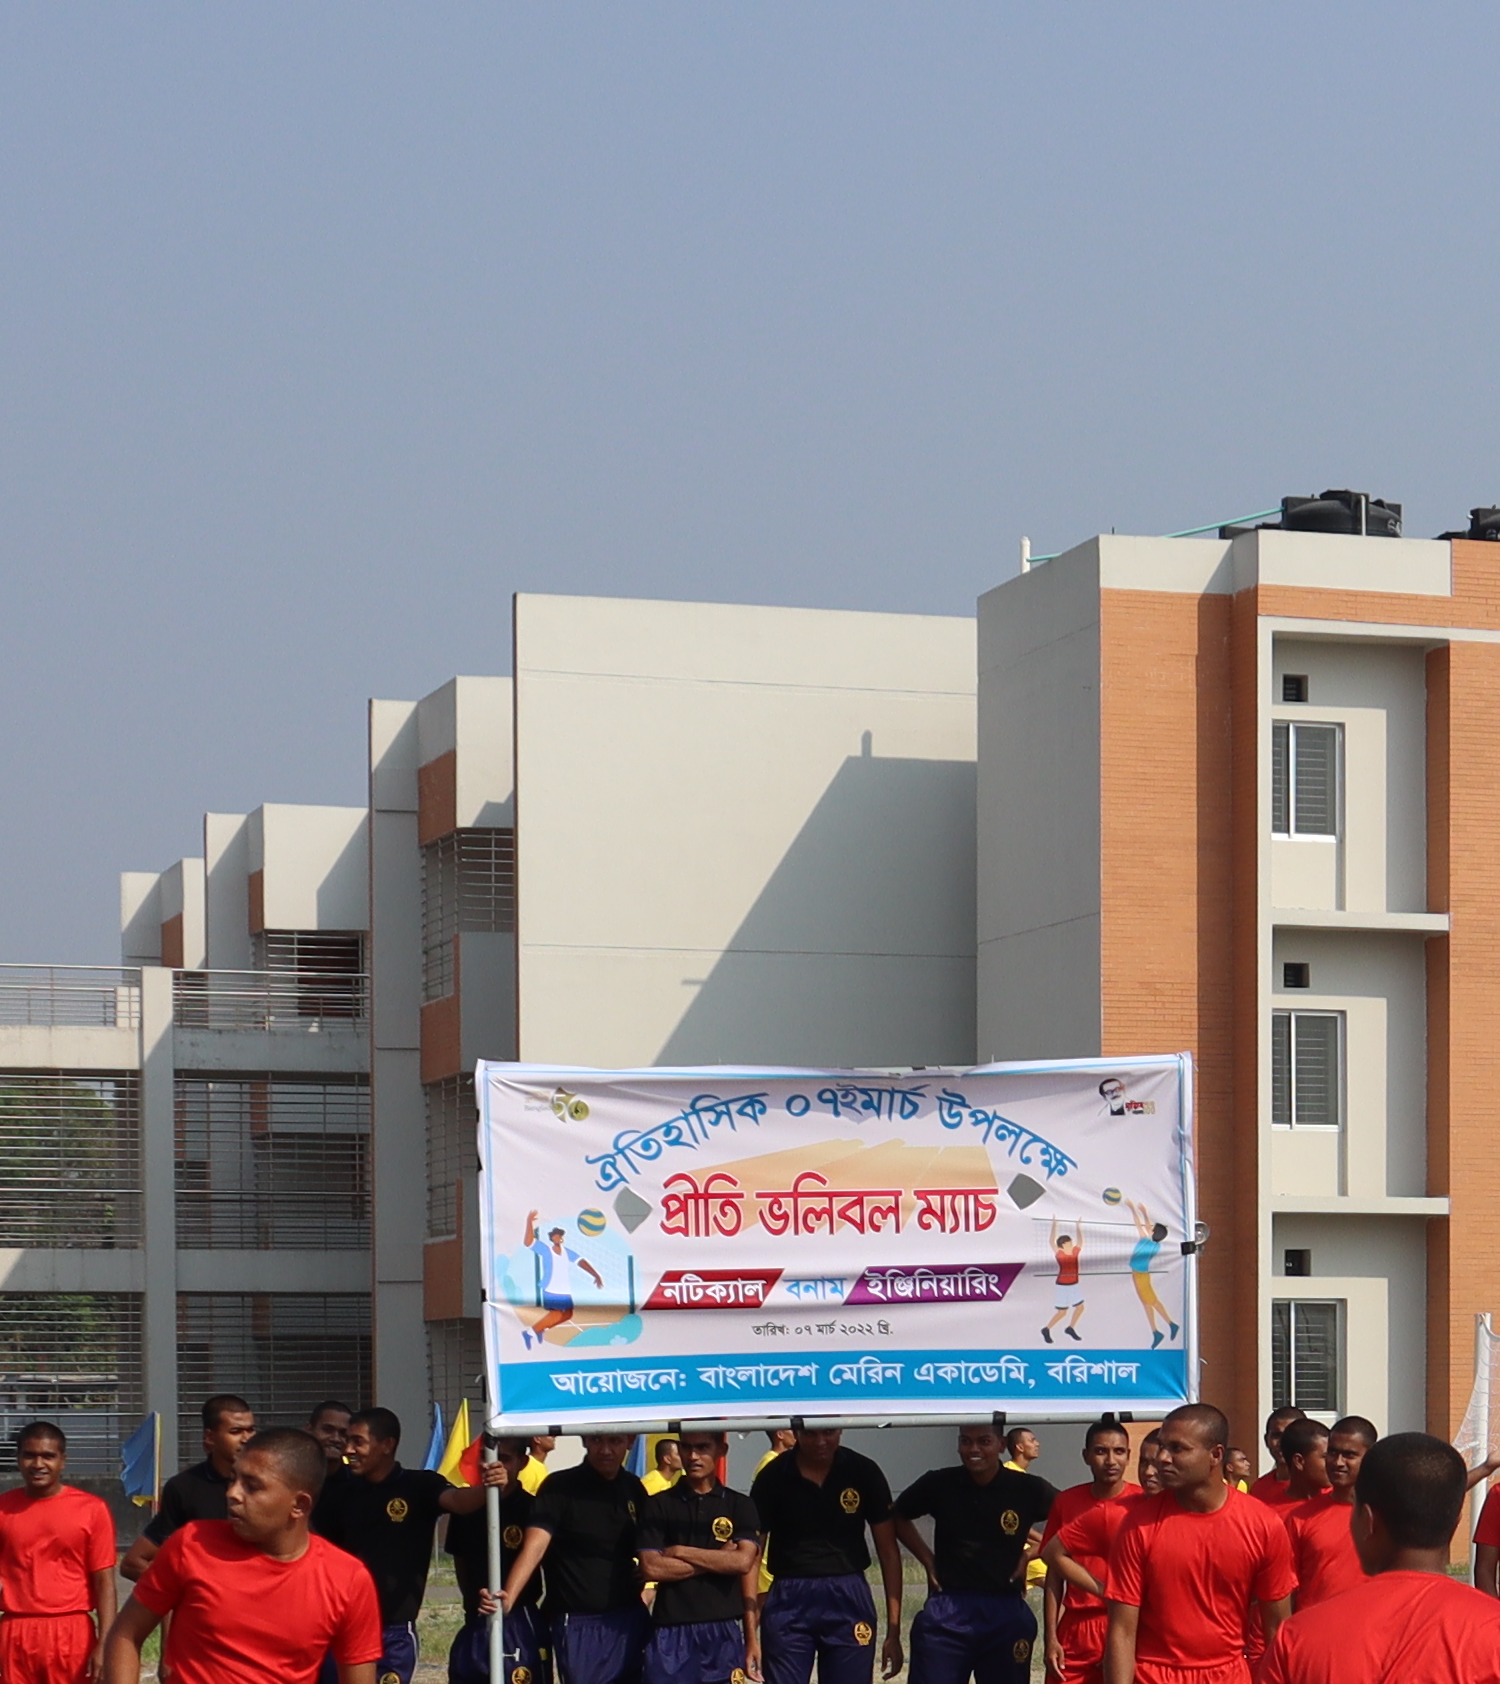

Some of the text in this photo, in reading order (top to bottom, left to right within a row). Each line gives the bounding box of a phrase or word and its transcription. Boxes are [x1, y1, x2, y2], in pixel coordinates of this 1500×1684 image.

[585, 1092, 769, 1191] ঐতিহাসিক
[935, 1088, 1079, 1181] উপলক্ষে
[660, 1171, 999, 1237] প্রীতি ভলিবল ম্যাচ
[659, 1273, 767, 1306] নটিক্যাল
[782, 1275, 848, 1301] বনাম
[697, 1361, 819, 1391] বাংলাদেশ
[828, 1356, 905, 1388] মেরিন
[913, 1354, 1036, 1390] একাডেমি,
[1045, 1354, 1142, 1385] বরিশাল
